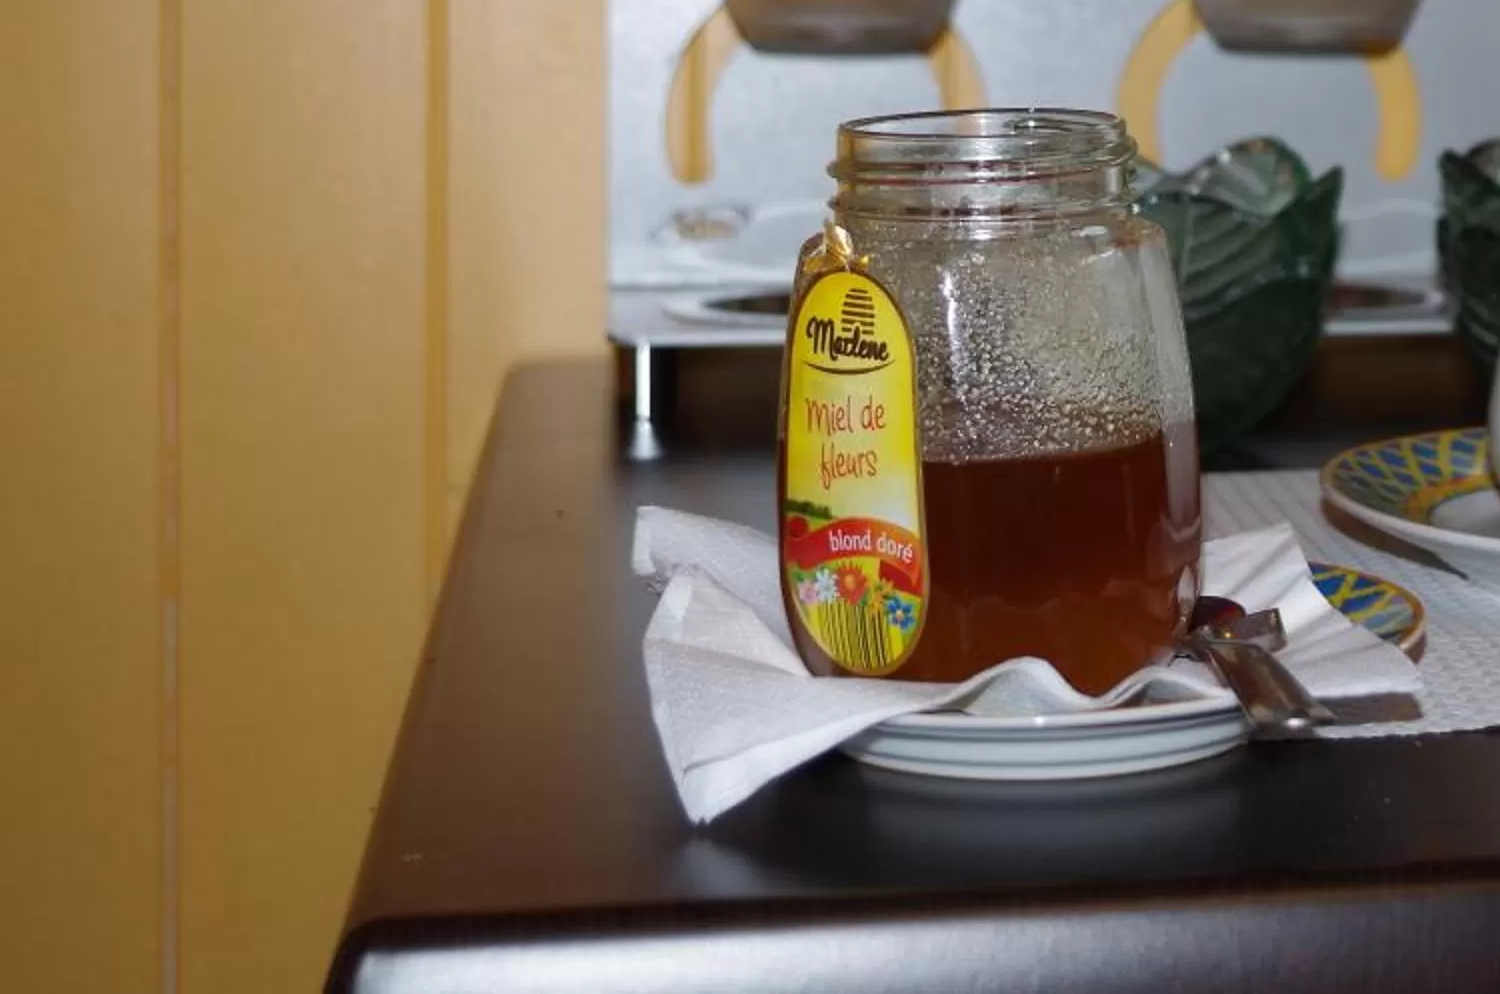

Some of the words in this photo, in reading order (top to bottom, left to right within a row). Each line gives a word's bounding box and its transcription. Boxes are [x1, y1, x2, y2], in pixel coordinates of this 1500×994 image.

[804, 394, 854, 436] Miel
[861, 393, 886, 431] de
[819, 442, 878, 491] fleurs
[828, 529, 873, 553] blond
[876, 531, 913, 564] doré
